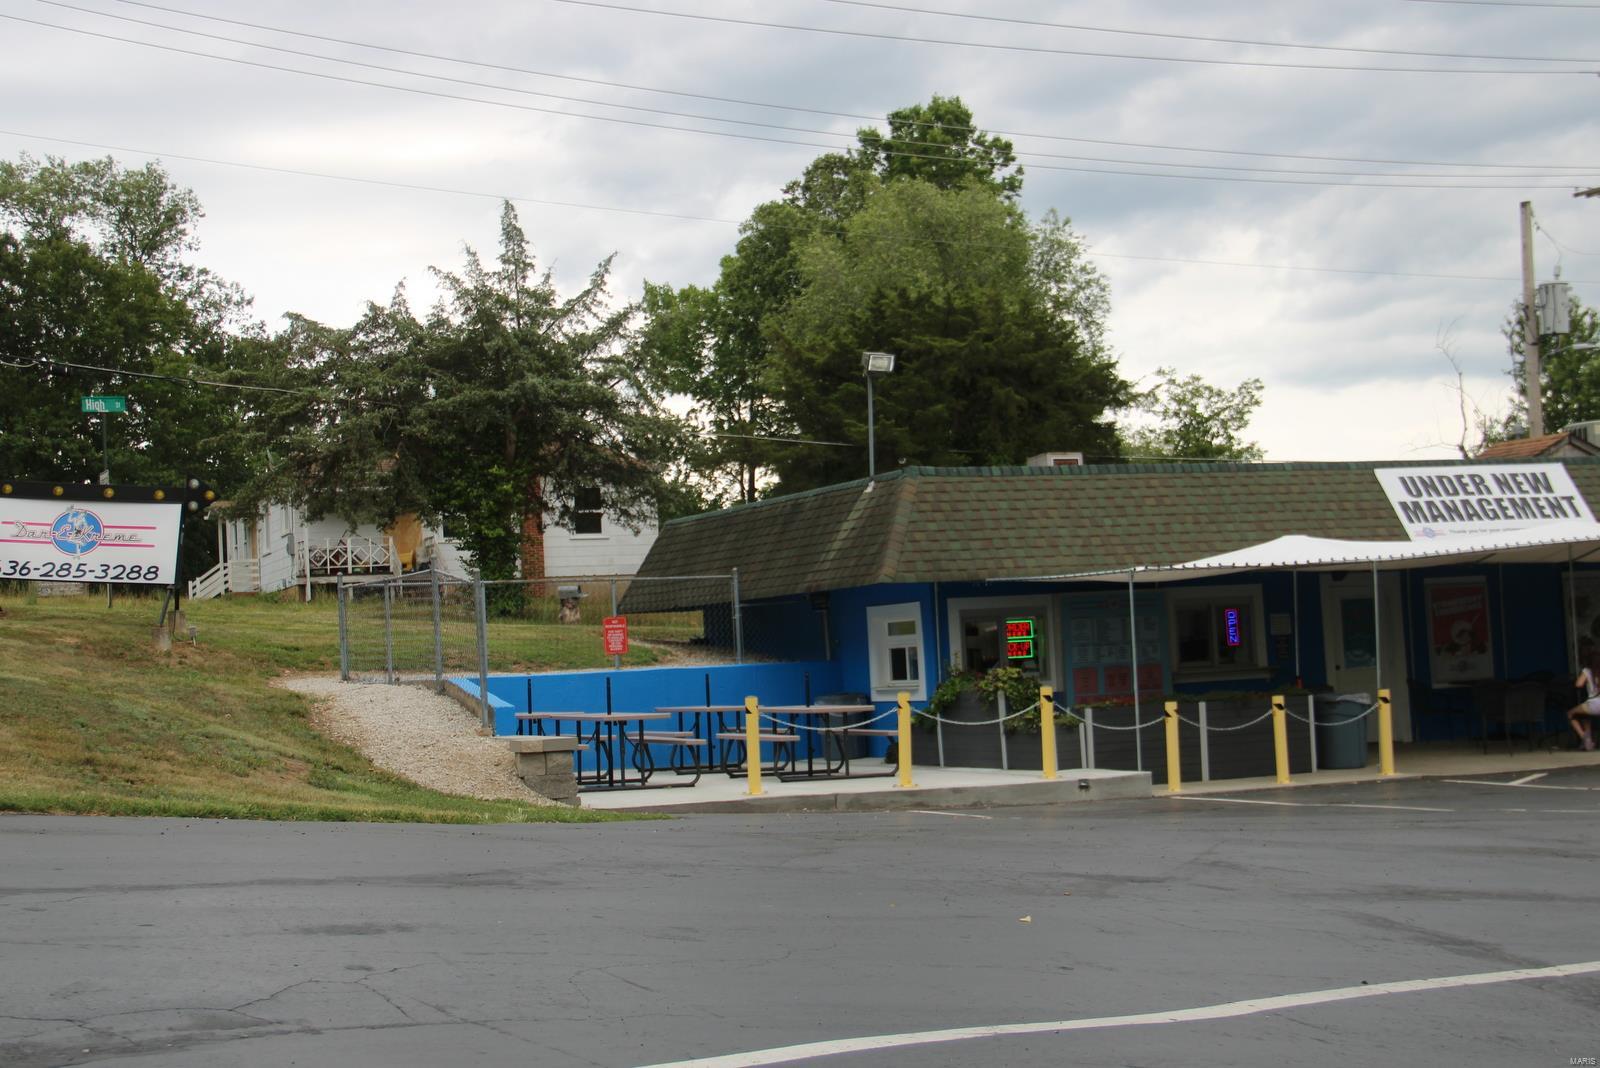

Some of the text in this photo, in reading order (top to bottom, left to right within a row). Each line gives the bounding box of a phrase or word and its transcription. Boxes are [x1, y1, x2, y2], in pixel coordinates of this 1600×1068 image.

[85, 398, 106, 412] High
[1398, 472, 1554, 498] UNDER NEW
[1398, 496, 1582, 524] MANAGEMENT
[1227, 610, 1240, 643] OPEN
